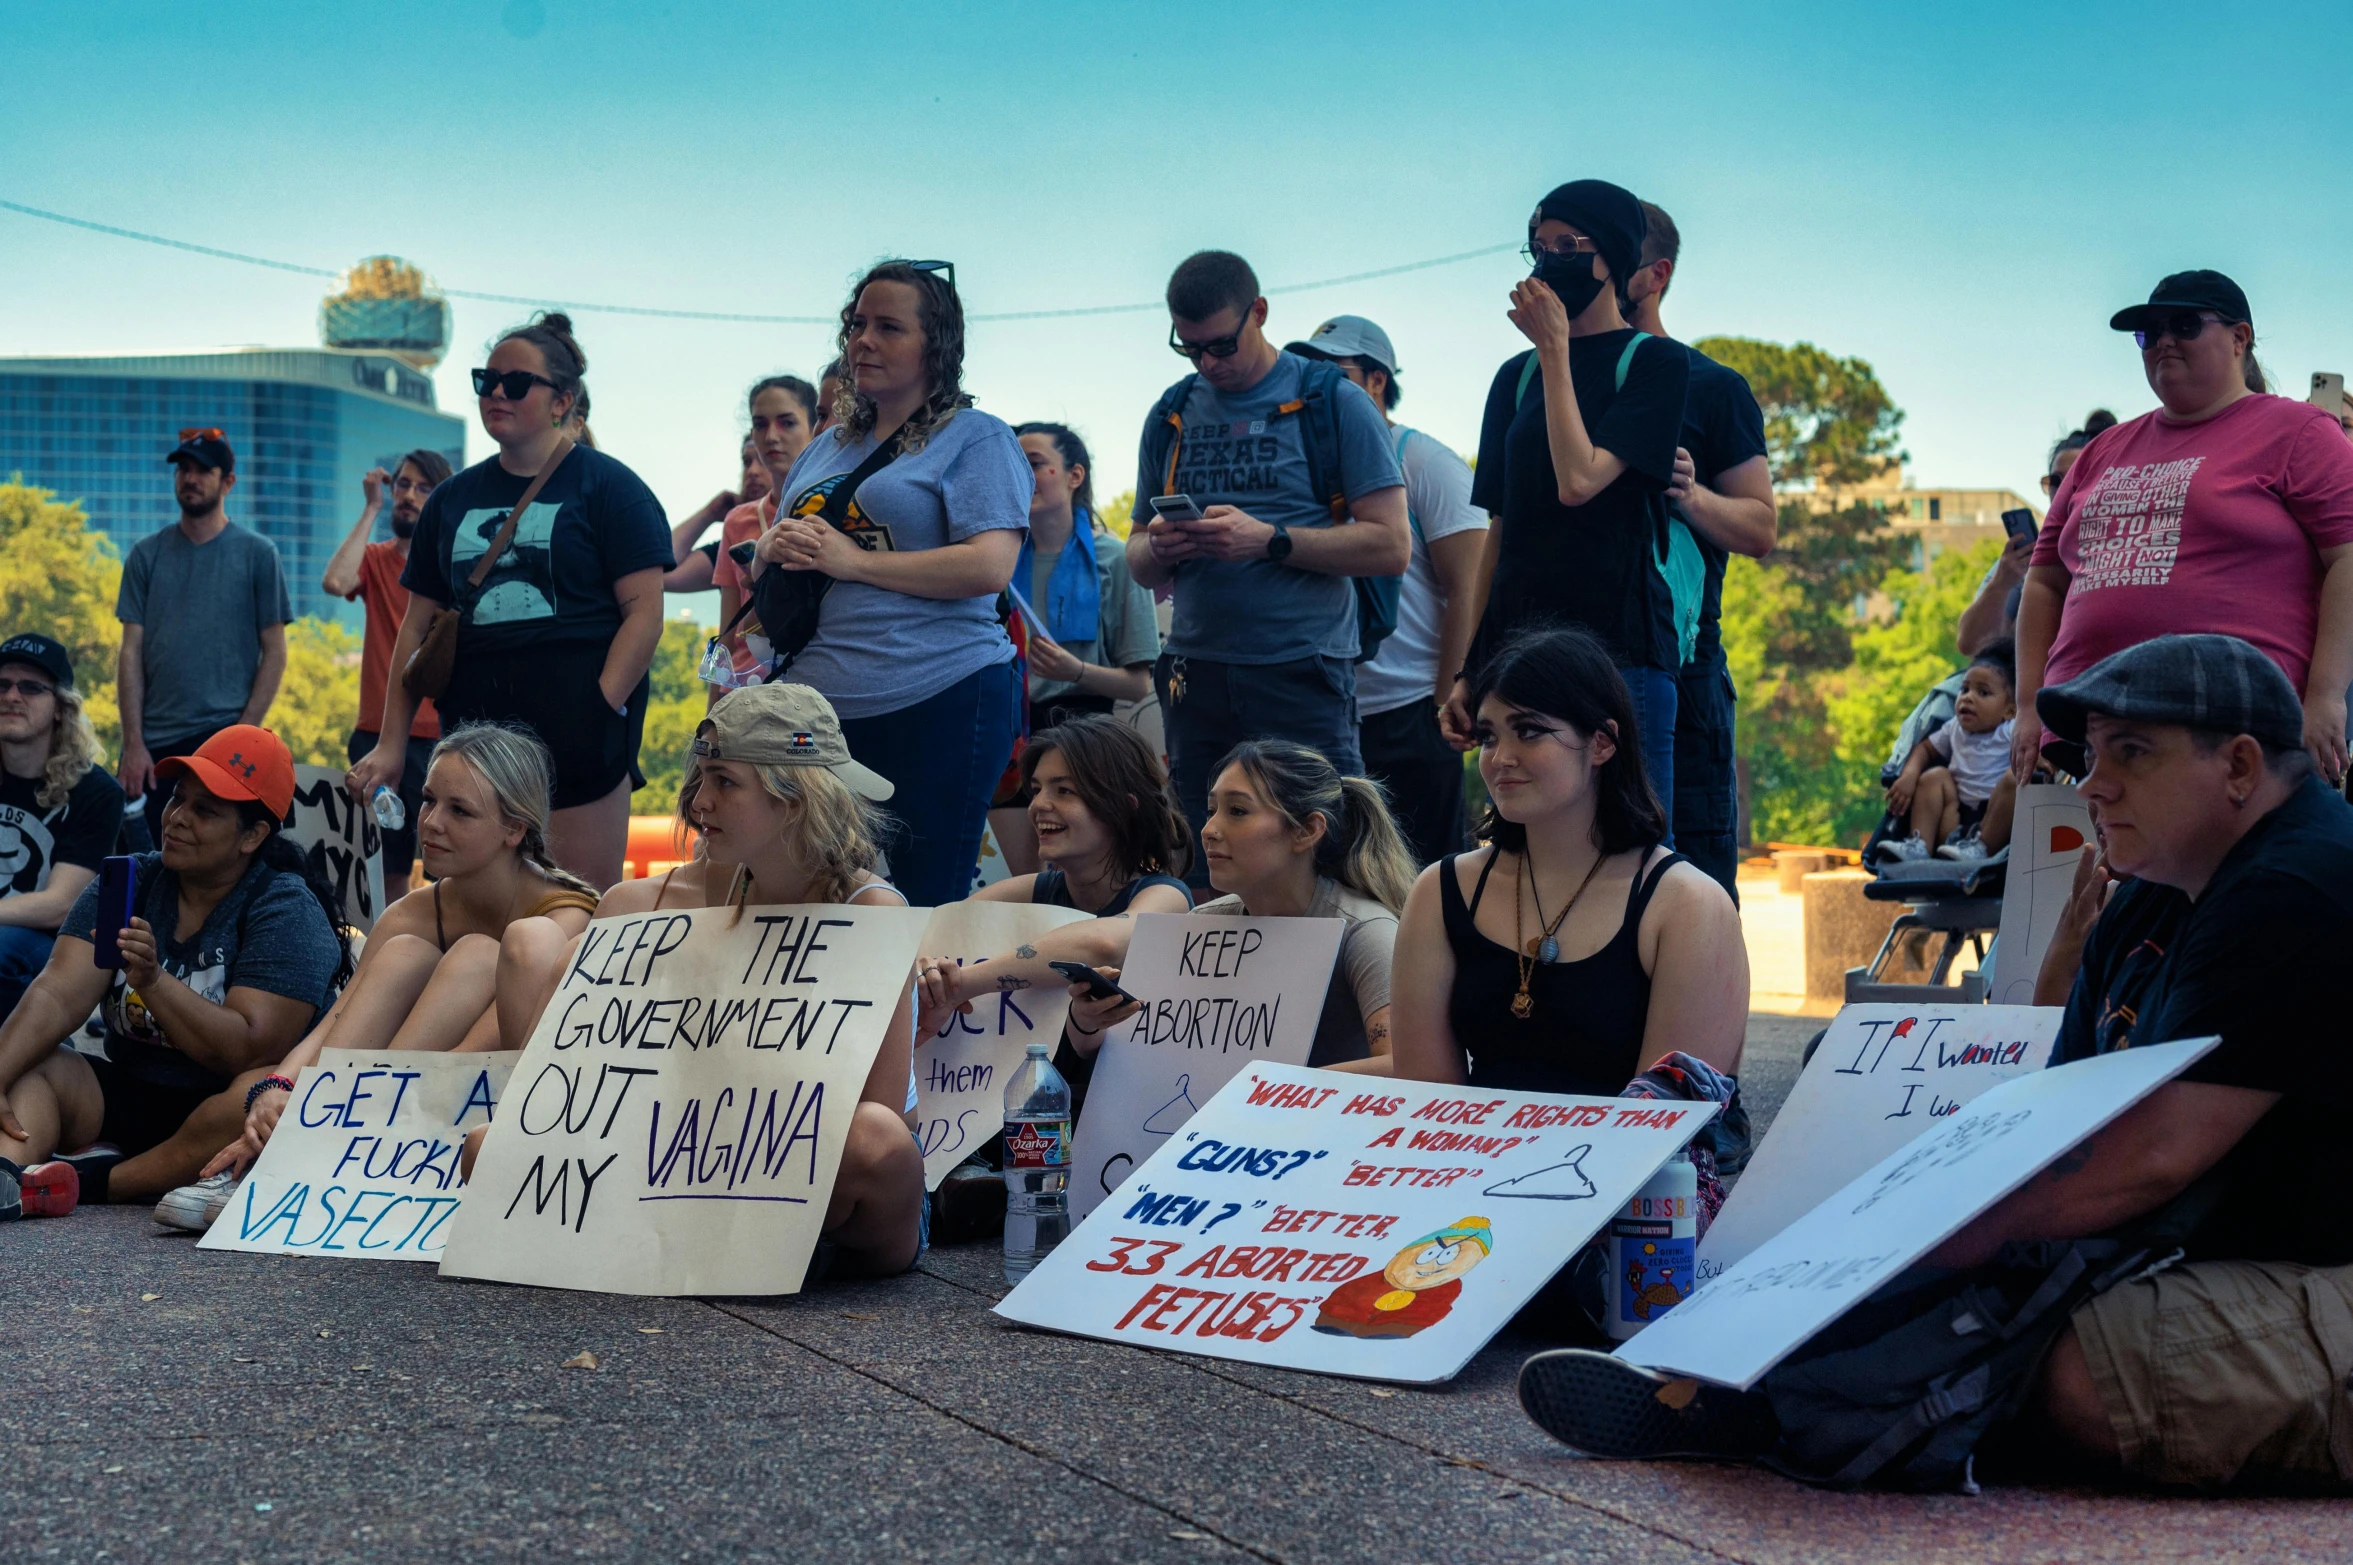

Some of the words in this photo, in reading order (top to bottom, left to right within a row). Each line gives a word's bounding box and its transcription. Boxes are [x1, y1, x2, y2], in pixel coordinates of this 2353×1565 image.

[1173, 466, 1279, 494] ACTICAL
[2101, 456, 2206, 480] PRO-CHOICE
[2150, 470, 2196, 488] BELIEVE
[2082, 502, 2150, 518] WOMEN
[2154, 495, 2186, 510] THE
[2084, 491, 2100, 507] IN
[2103, 491, 2140, 502] GIVING
[2142, 480, 2191, 502] OTHER
[2078, 519, 2112, 541] RIGHT
[2116, 515, 2146, 536] TO
[2149, 511, 2183, 531] MAKE
[2077, 531, 2181, 557] CHOICES
[2082, 550, 2136, 573] MIGHT
[2141, 549, 2176, 563] NOT
[2105, 577, 2170, 588] MYSELF
[283, 779, 355, 845] MY
[564, 914, 691, 990] KEEP
[742, 915, 854, 985] THE
[1179, 928, 1262, 978] KEEP
[554, 992, 872, 1054] GOVERNMENT
[1130, 993, 1281, 1054] ABORTION
[1901, 1018, 1956, 1072] I
[925, 1057, 993, 1093] them
[300, 1071, 421, 1128] GET
[454, 1069, 498, 1126] A
[520, 1063, 659, 1139] OUT
[1245, 1074, 1339, 1109] "WHAT
[1341, 1094, 1406, 1117] HAS
[1410, 1099, 1506, 1125] MORE
[1502, 1103, 1615, 1130] RIGHTS
[1611, 1109, 1688, 1131] THAN
[1885, 1084, 1924, 1120] I
[504, 1153, 618, 1232] MY
[648, 1080, 824, 1190] VAGINA
[1012, 1139, 1048, 1150] Ozarka
[1366, 1127, 1406, 1149] A
[1407, 1129, 1540, 1159] WOMAN?"
[332, 1133, 468, 1191] FUCKi
[1343, 1159, 1483, 1188] "BETTER"
[1632, 1197, 1673, 1217] BOSS
[1642, 1226, 1670, 1235] NATION
[1085, 1236, 1185, 1276] 33
[1176, 1244, 1370, 1283] ABORTED
[1648, 1258, 1669, 1266] ZERO
[1659, 1248, 1685, 1256] GIVING
[1696, 1259, 1724, 1280] But
[1114, 1283, 1323, 1342] FETUSES"
